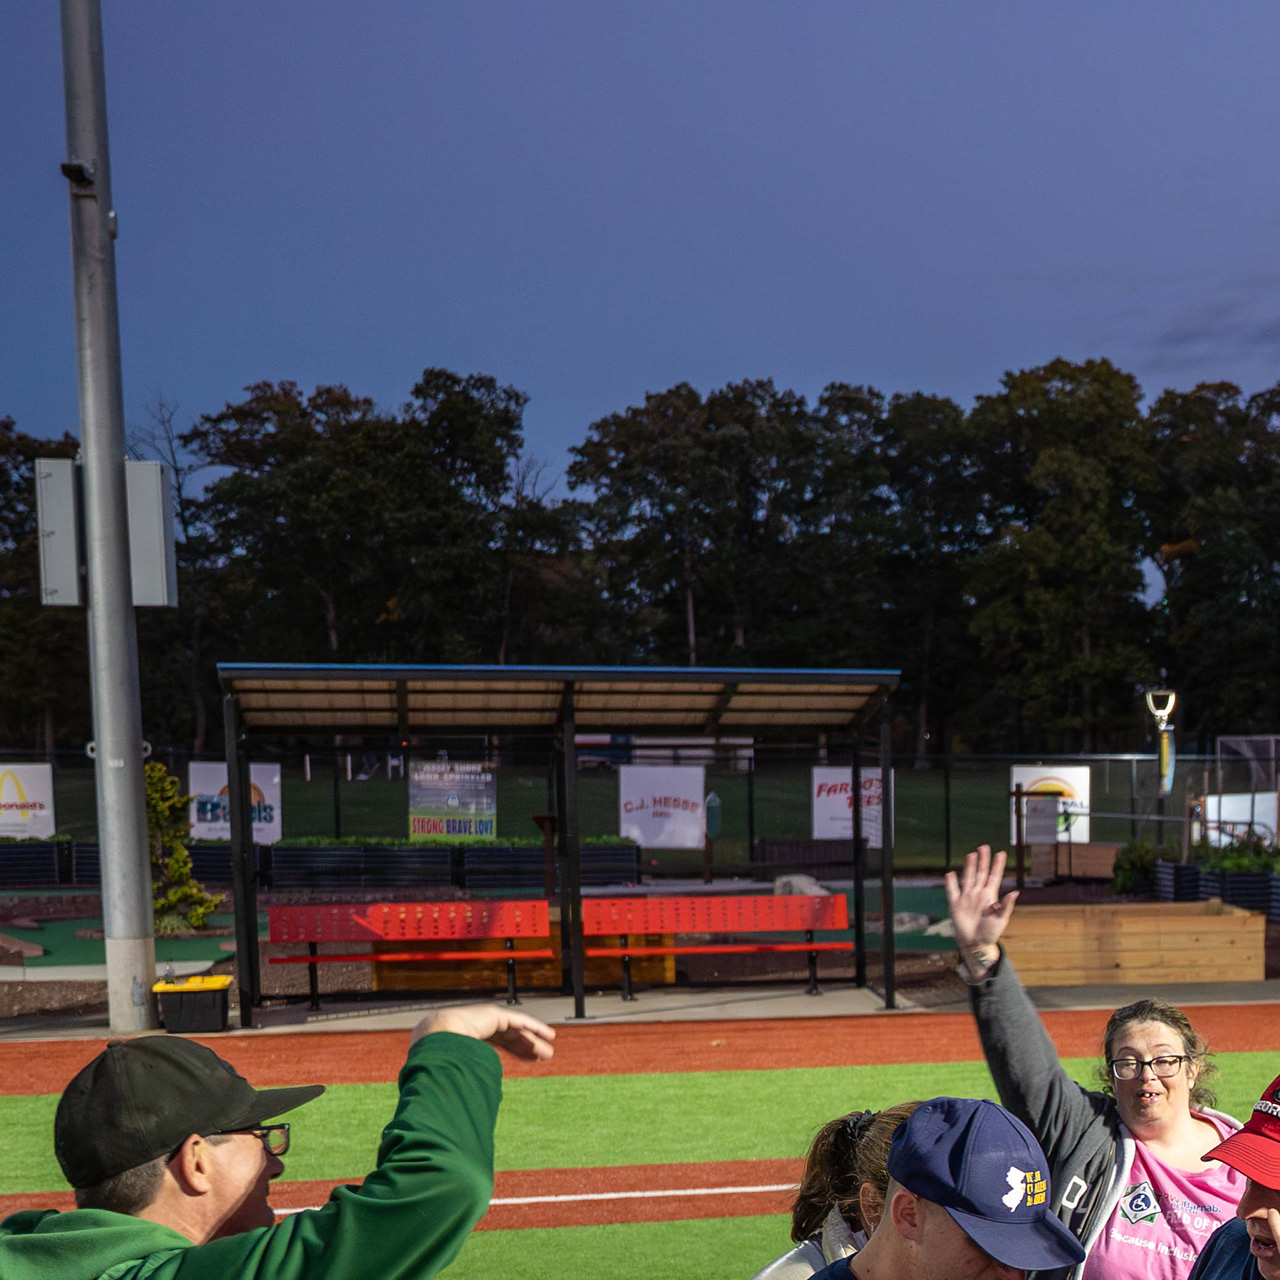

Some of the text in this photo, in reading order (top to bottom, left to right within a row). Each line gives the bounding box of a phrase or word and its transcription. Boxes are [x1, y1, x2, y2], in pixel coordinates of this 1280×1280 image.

[652, 795, 700, 814] HESSE
[412, 817, 494, 836] STRONG BRAVE LOVE
[1194, 1216, 1210, 1230] OF
[1110, 1228, 1156, 1251] Because
[1157, 1242, 1198, 1262] Inclusio
